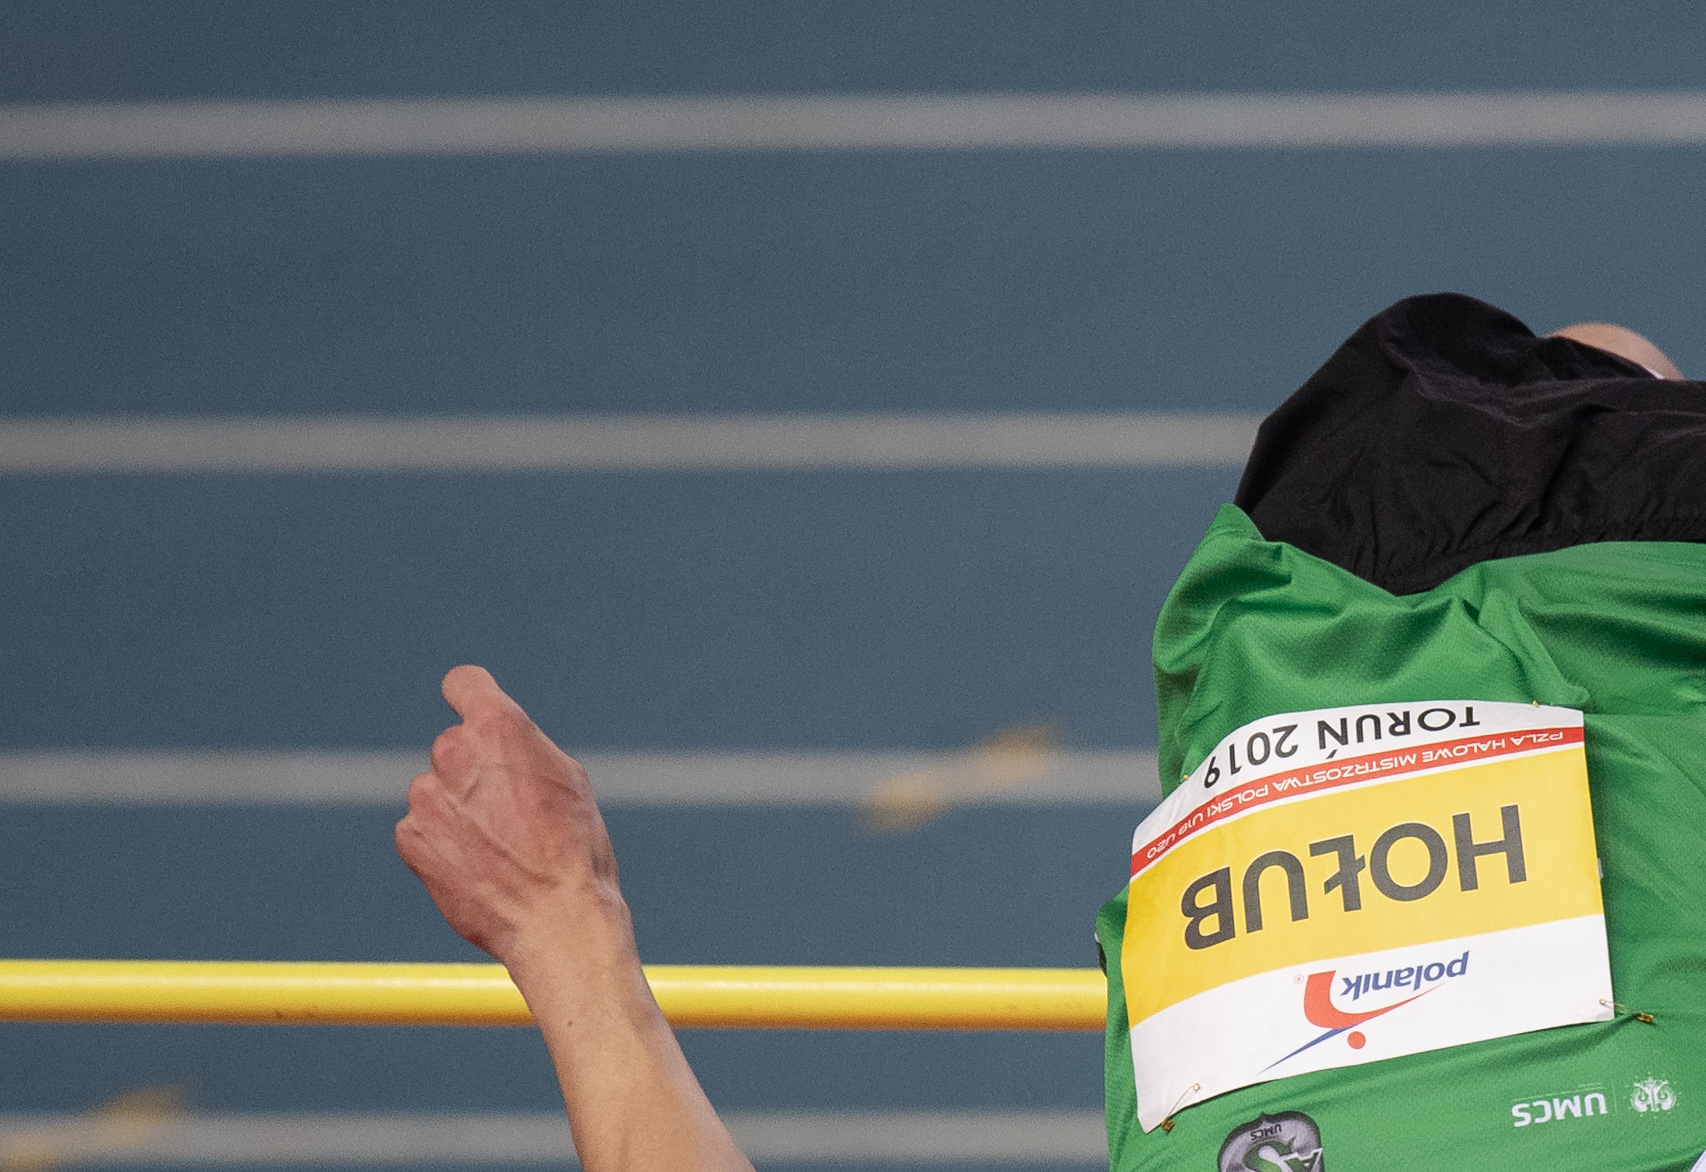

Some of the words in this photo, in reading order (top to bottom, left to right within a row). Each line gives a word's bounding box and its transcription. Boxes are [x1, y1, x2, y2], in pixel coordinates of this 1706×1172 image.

[1317, 706, 1481, 759] TORUŃ
[1422, 738, 1506, 762] HALOWE
[1509, 731, 1564, 746] PZLA
[1203, 724, 1299, 789] 2019
[1272, 752, 1417, 792] MISTRZOSTWA
[1206, 786, 1269, 817] POLSKI
[1146, 832, 1176, 859] U20
[1180, 804, 1528, 950] HOŁUB
[1340, 950, 1470, 1001] polanik
[1511, 1092, 1608, 1128] UMCS
[1250, 1124, 1283, 1141] UMCS
